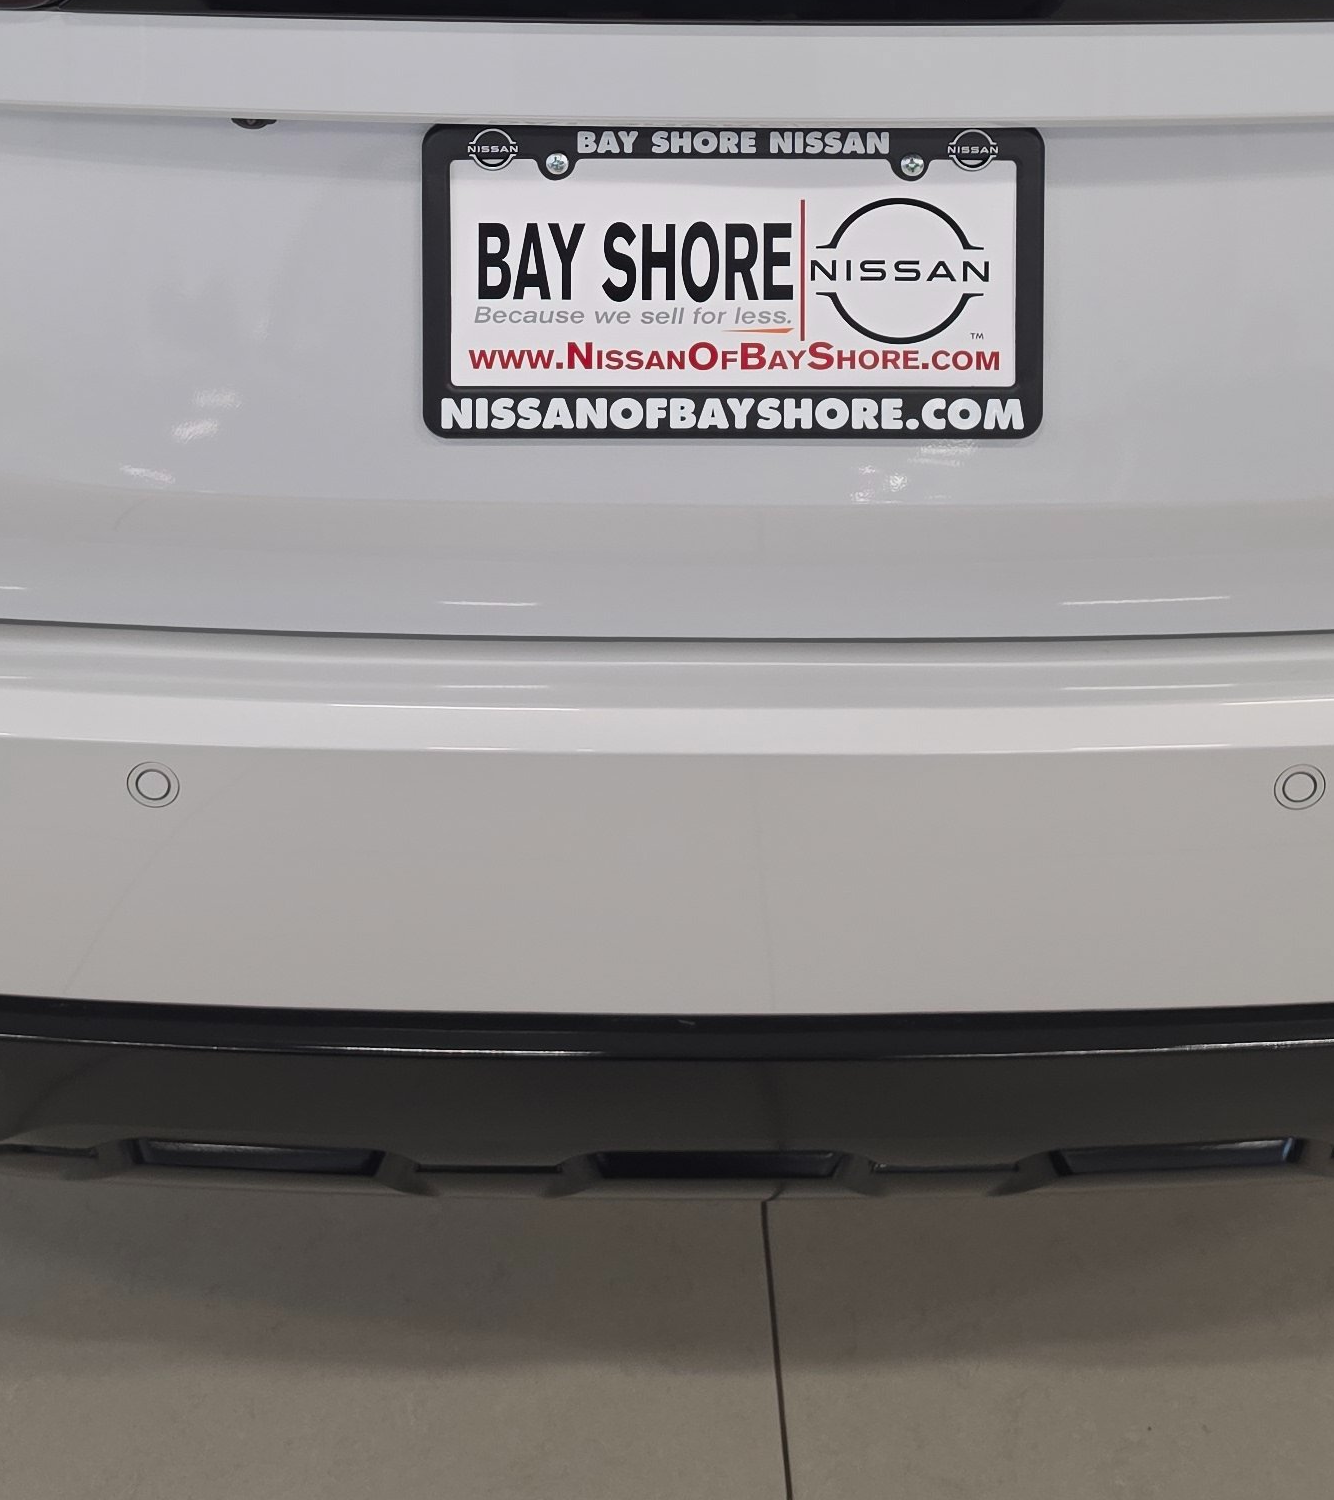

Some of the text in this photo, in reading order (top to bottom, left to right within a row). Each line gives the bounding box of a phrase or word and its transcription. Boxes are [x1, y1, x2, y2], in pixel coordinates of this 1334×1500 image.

[467, 145, 519, 153] NISSAN
[576, 130, 890, 155] BAY SHORE NISSAN
[947, 145, 999, 154] NISSAN
[477, 221, 794, 303] BAY SHORE
[810, 259, 990, 283] NISSAN
[474, 306, 793, 325] Because we sell for less.
[440, 397, 1025, 431] NISSANOFBAYSHORE.COM
